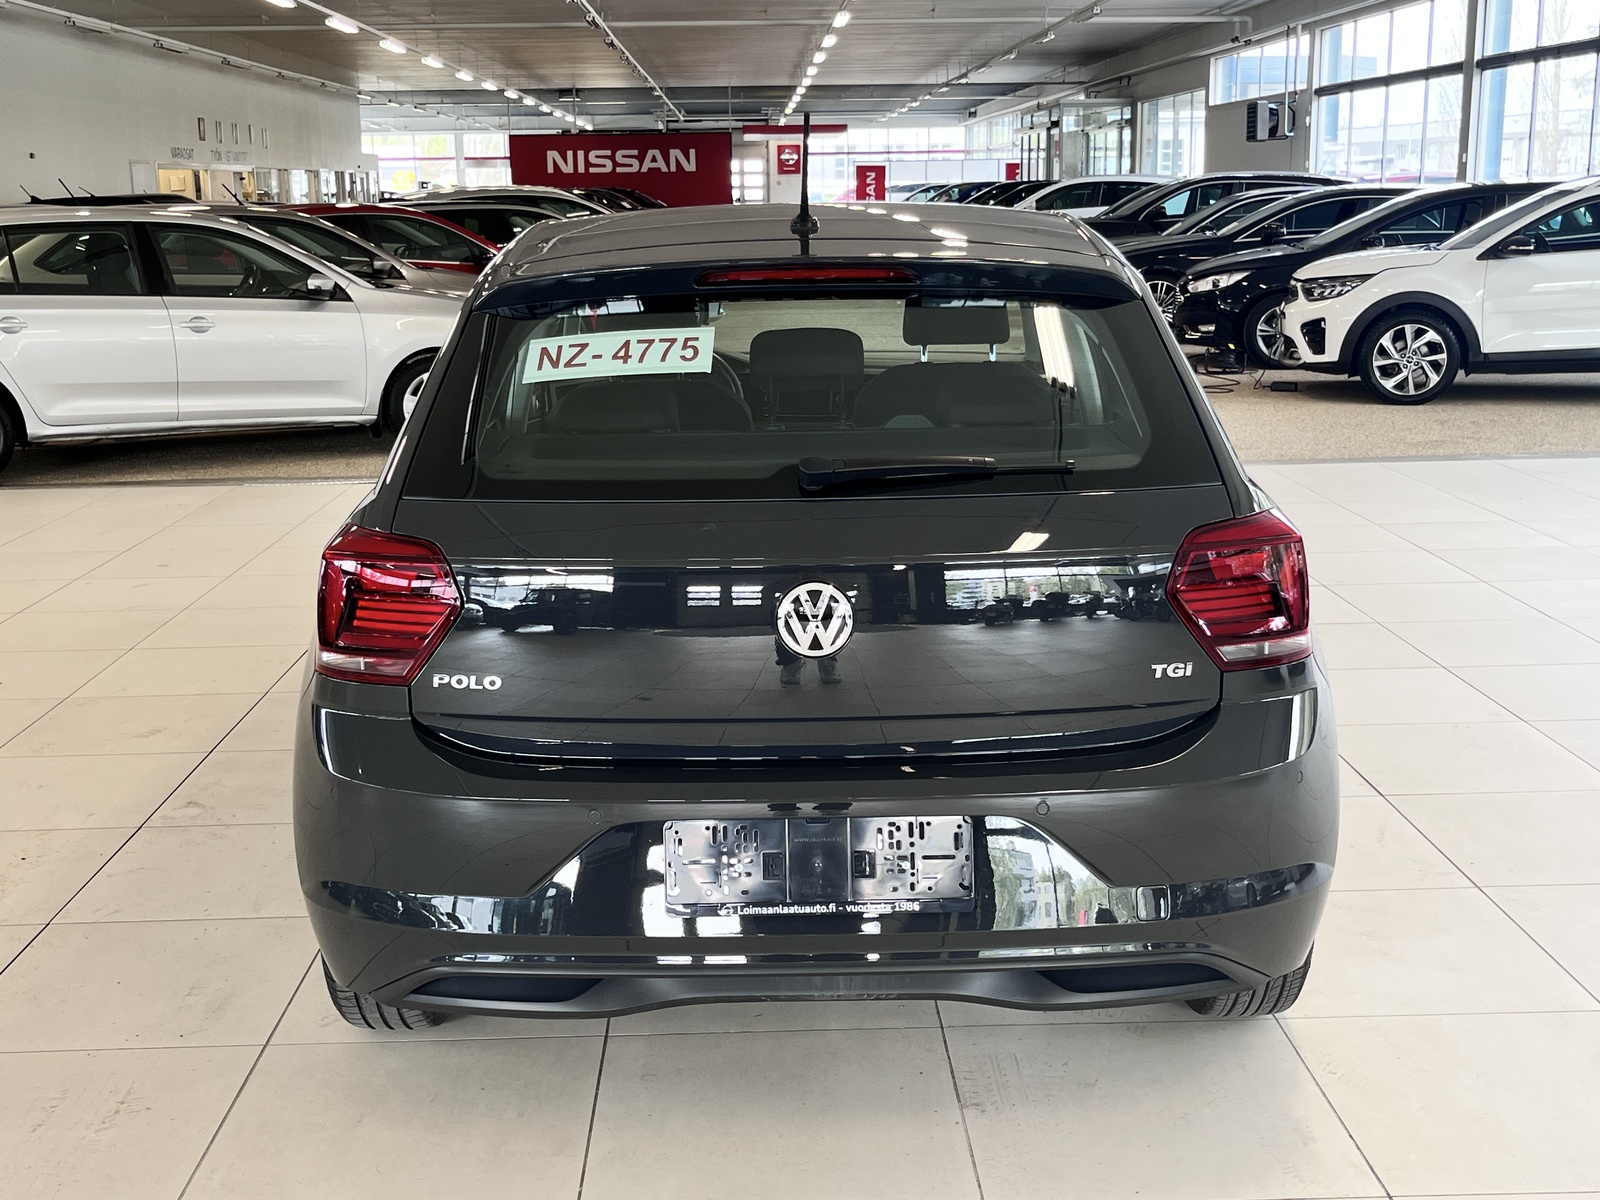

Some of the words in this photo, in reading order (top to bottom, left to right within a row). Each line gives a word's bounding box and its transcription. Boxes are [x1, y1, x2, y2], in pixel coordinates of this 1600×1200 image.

[546, 149, 696, 174] NISSAN
[432, 673, 503, 691] POLO
[737, 902, 836, 915] Loimaanlaatuauto.fi
[845, 902, 892, 913] vuodesta
[893, 901, 920, 912] 1986
